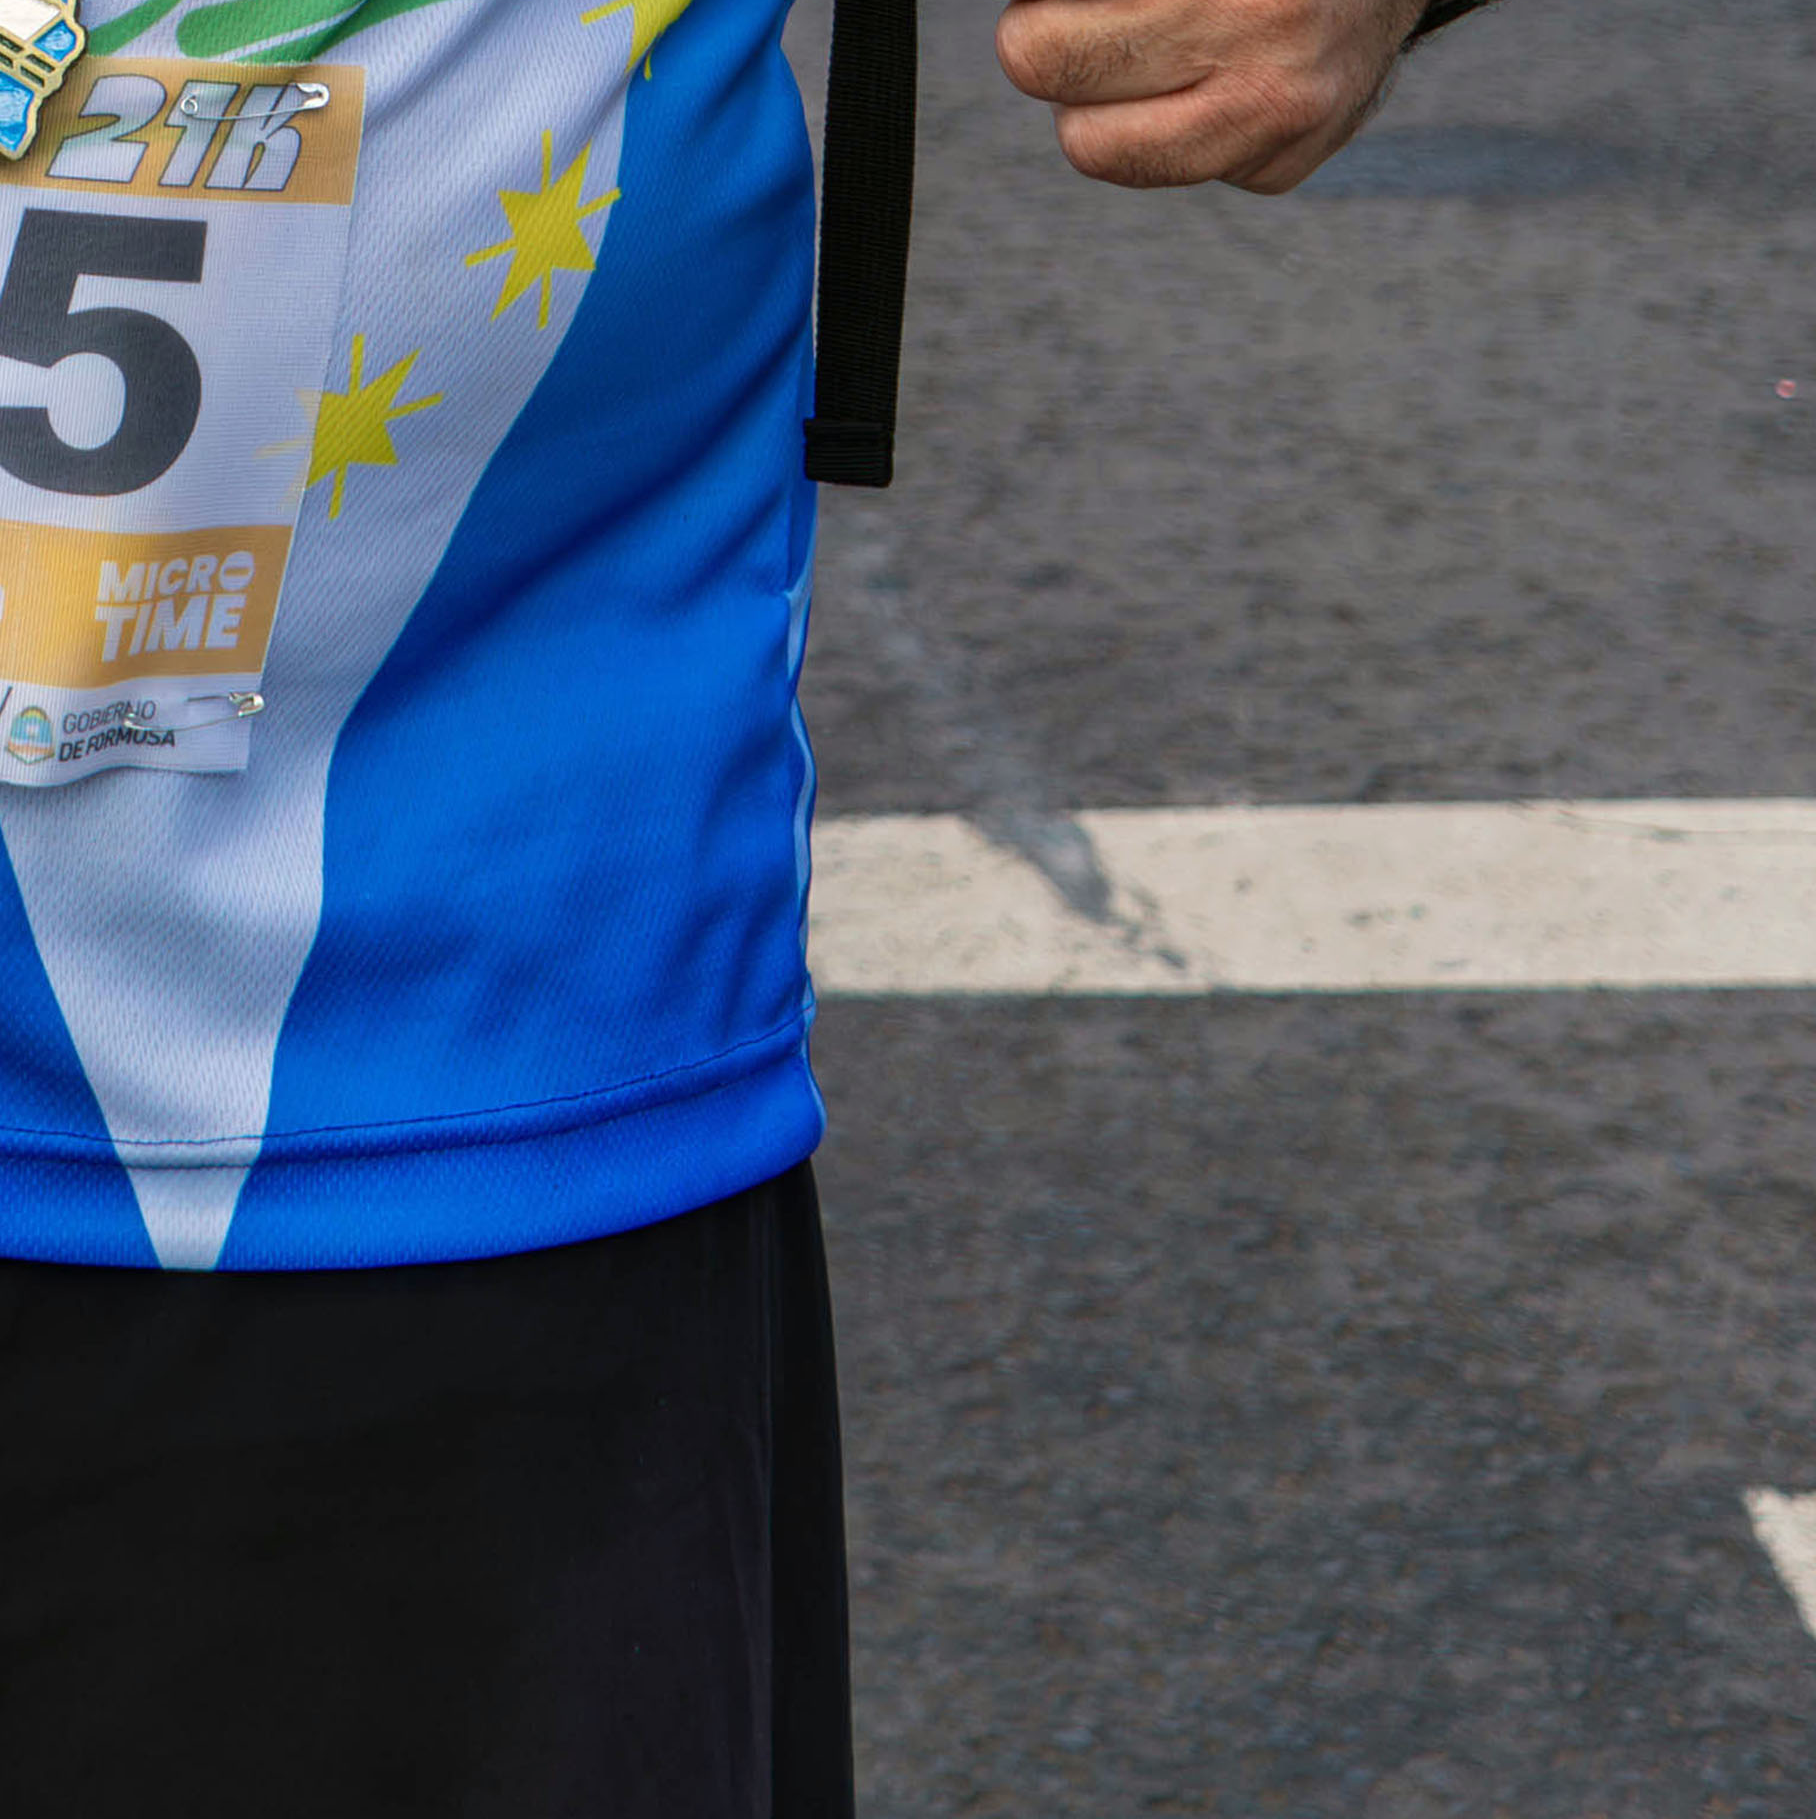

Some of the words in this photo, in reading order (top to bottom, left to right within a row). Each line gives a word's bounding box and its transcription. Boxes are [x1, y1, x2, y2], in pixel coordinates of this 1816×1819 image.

[45, 74, 304, 192] 21K
[96, 550, 256, 604] MICRO
[94, 594, 248, 662] TIME
[62, 700, 157, 735] GOBIERNO
[58, 741, 82, 763] DE
[85, 727, 176, 759] FORMOSA
